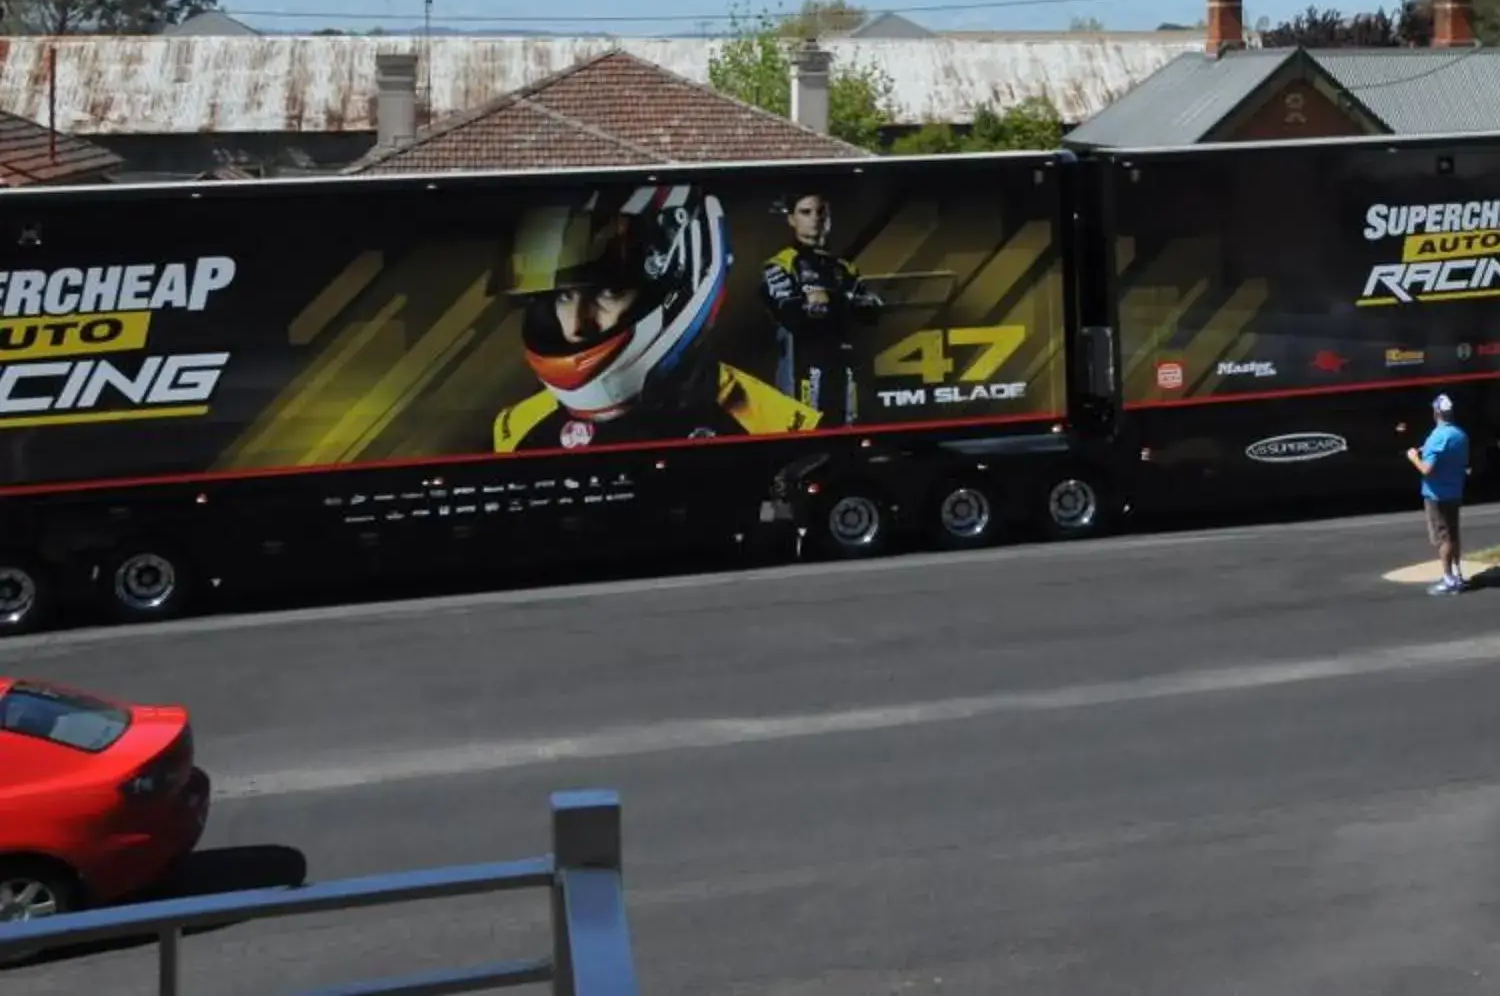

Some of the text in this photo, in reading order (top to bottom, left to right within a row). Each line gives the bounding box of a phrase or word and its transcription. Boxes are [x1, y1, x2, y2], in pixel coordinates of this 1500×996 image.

[0, 256, 237, 317] RCHEAP
[874, 326, 1025, 384] 47
[877, 381, 1027, 407] TIM SLADE
